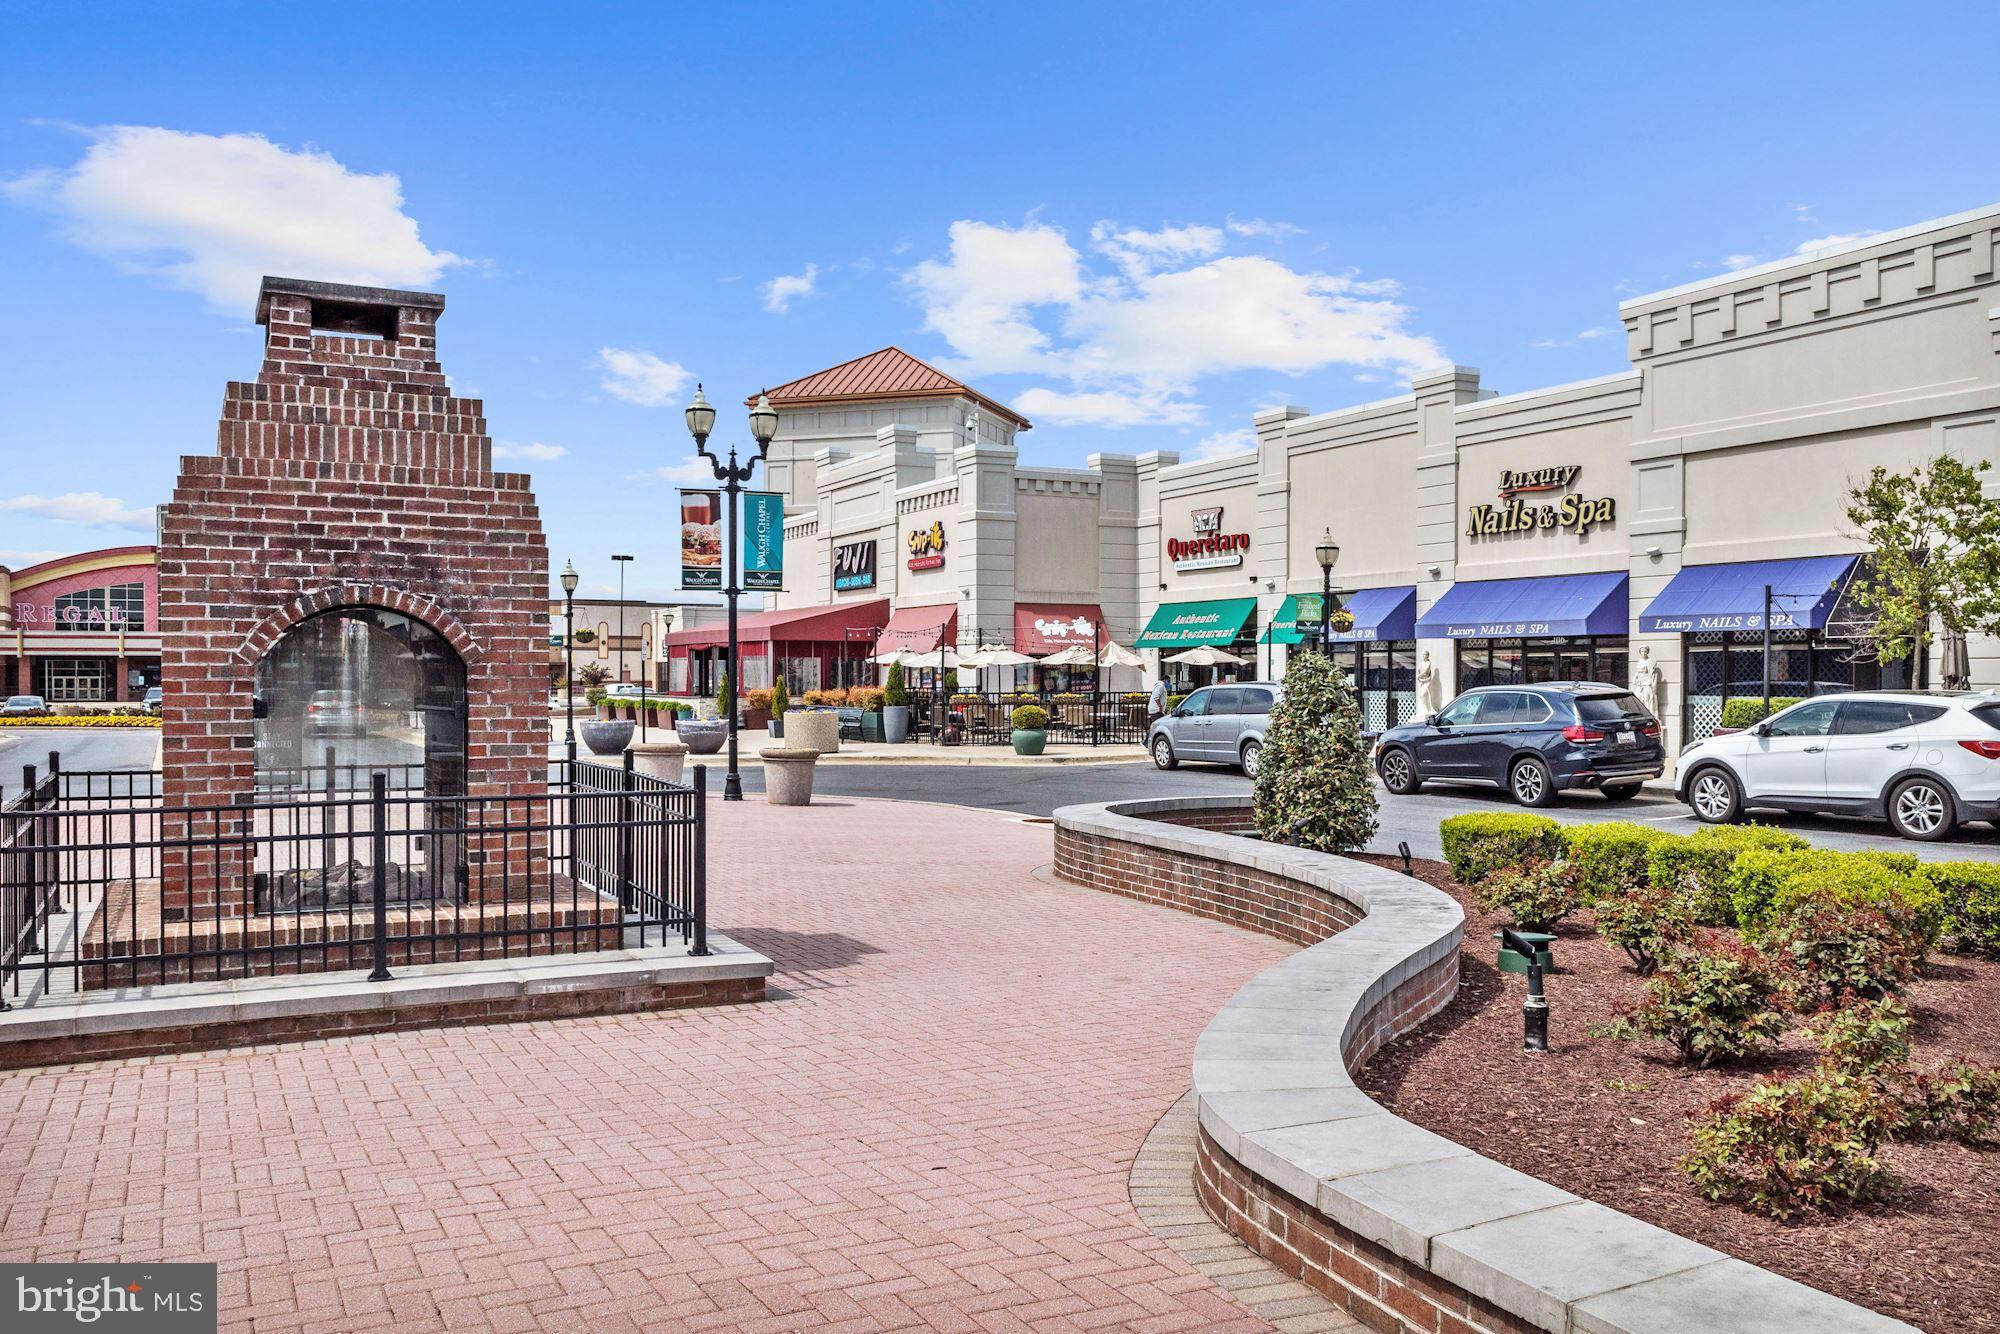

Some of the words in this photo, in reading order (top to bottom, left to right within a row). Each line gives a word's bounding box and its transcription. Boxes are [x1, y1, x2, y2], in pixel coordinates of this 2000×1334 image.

[1498, 465, 1581, 489] Luxury
[1466, 499, 1537, 536] Nails
[1537, 505, 1557, 529] &
[1558, 494, 1616, 534] Spa
[1168, 531, 1249, 561] Querétaro
[833, 542, 868, 575] FUJI
[16, 603, 126, 623] REGAL
[1172, 613, 1220, 624] Authentic
[1655, 619, 1693, 631] Luxury
[1700, 616, 1742, 628] NAILS
[1747, 616, 1761, 626] &
[1769, 614, 1794, 626] SPA
[1141, 630, 1178, 640] Mexican
[1179, 627, 1235, 639] Restaurant
[1447, 626, 1476, 638] Luxury
[1480, 625, 1511, 635] NAILS
[1515, 624, 1525, 634] &
[1529, 623, 1549, 634] SPA
